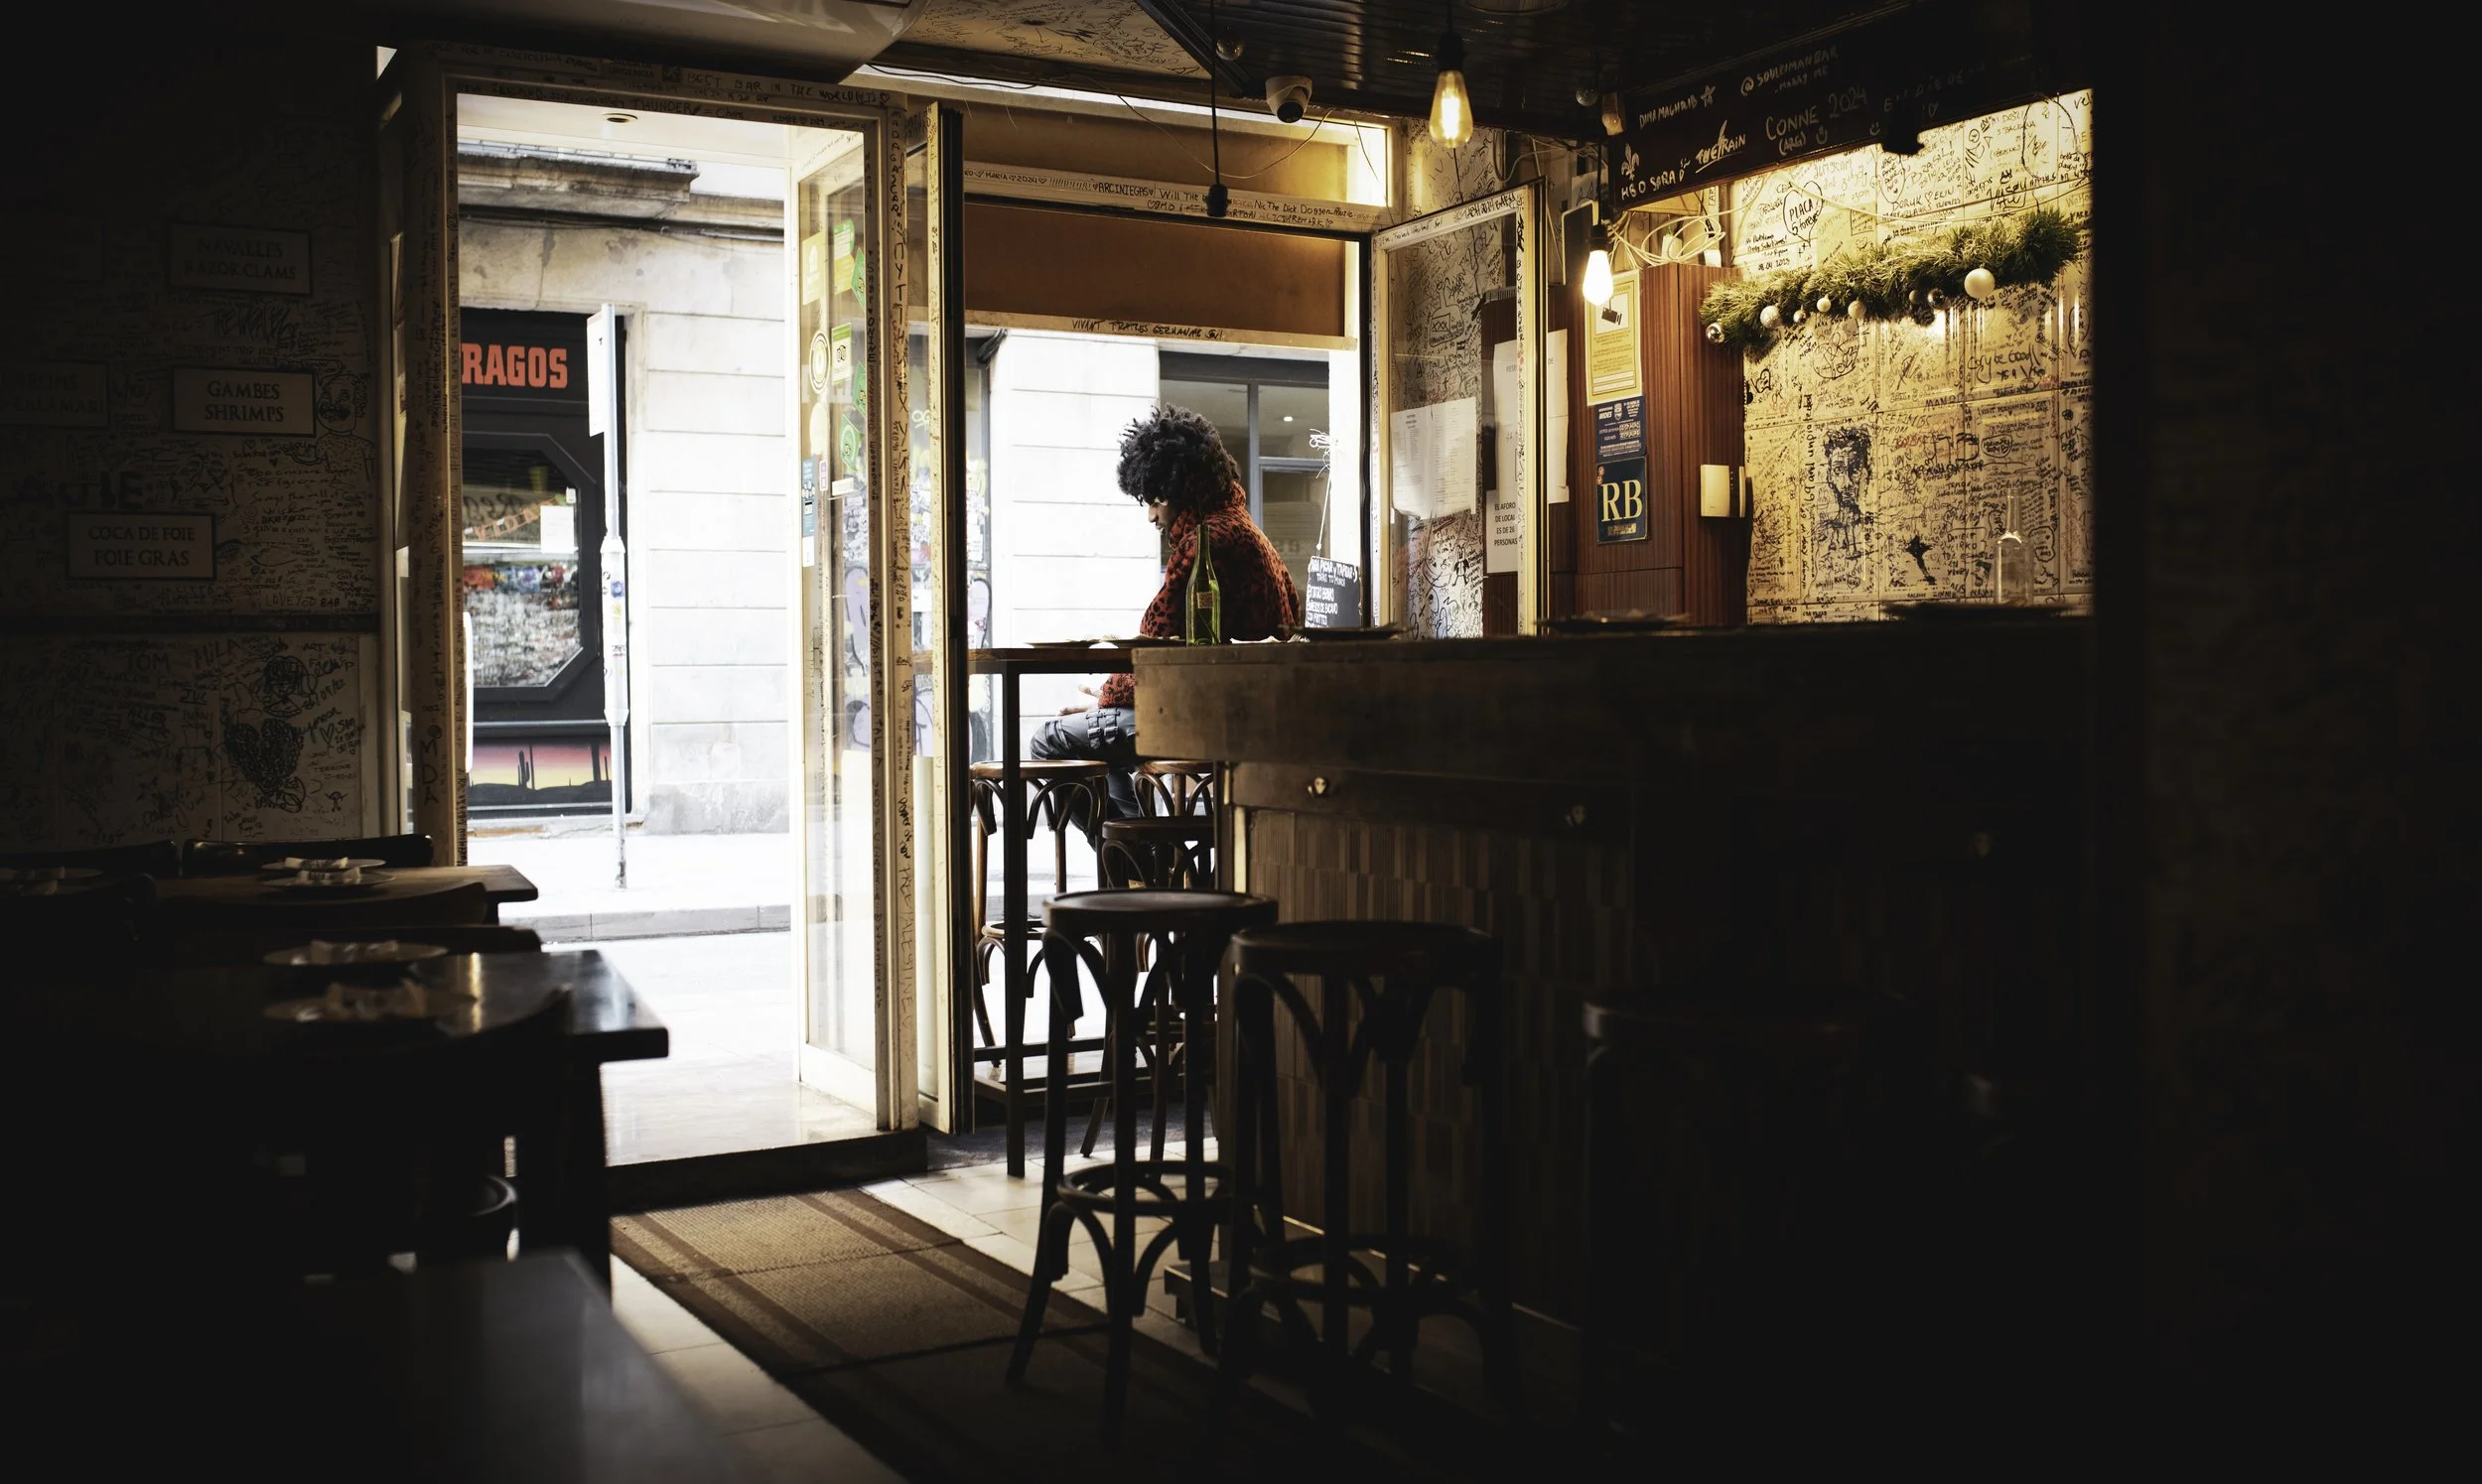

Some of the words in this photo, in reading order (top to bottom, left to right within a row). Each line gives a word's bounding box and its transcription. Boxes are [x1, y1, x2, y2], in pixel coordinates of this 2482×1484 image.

[734, 78, 763, 92] BAR
[789, 83, 814, 96] THE
[1765, 105, 1820, 142] CONNE
[1828, 82, 1868, 119] 2024
[1098, 181, 1150, 198] ARCINIEGAS
[1160, 189, 1180, 202] Will
[1789, 198, 1815, 221] PLACA
[199, 237, 284, 259] NAVALLES
[242, 263, 297, 280] CLAMS
[461, 342, 569, 389] RAGOS
[207, 379, 281, 400] GAMBES
[204, 403, 285, 422] SHRIMPS
[1500, 501, 1516, 510] AFORO
[1600, 478, 1643, 523] RB
[87, 526, 134, 541] COCA
[138, 526, 160, 541] DE
[163, 527, 196, 541] FOIE
[93, 549, 134, 567] FOIE
[138, 550, 190, 567] GRAS
